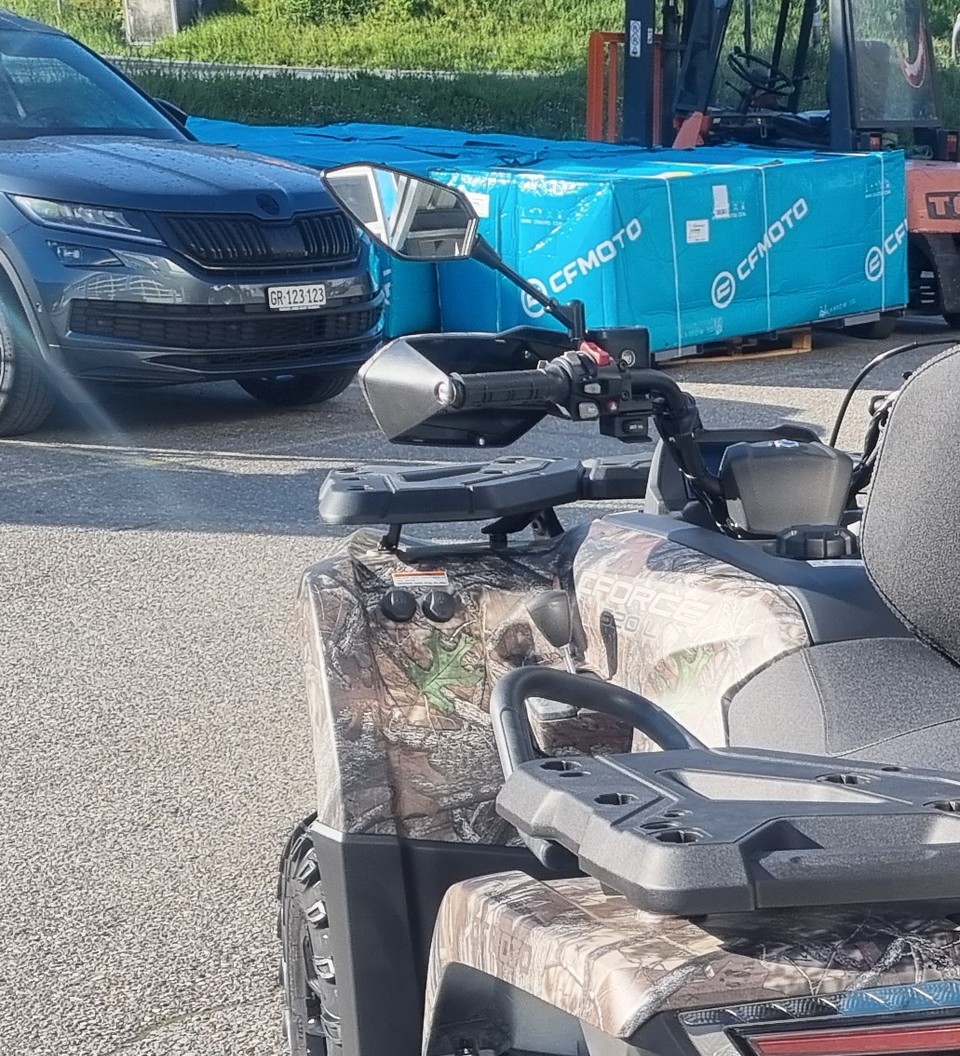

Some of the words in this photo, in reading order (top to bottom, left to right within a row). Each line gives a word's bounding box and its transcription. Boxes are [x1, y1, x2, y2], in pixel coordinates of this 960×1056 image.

[549, 218, 642, 293] CFMOTO
[736, 198, 809, 281] CFMOTO
[884, 218, 908, 255] CF
[577, 569, 713, 625] CFORCE
